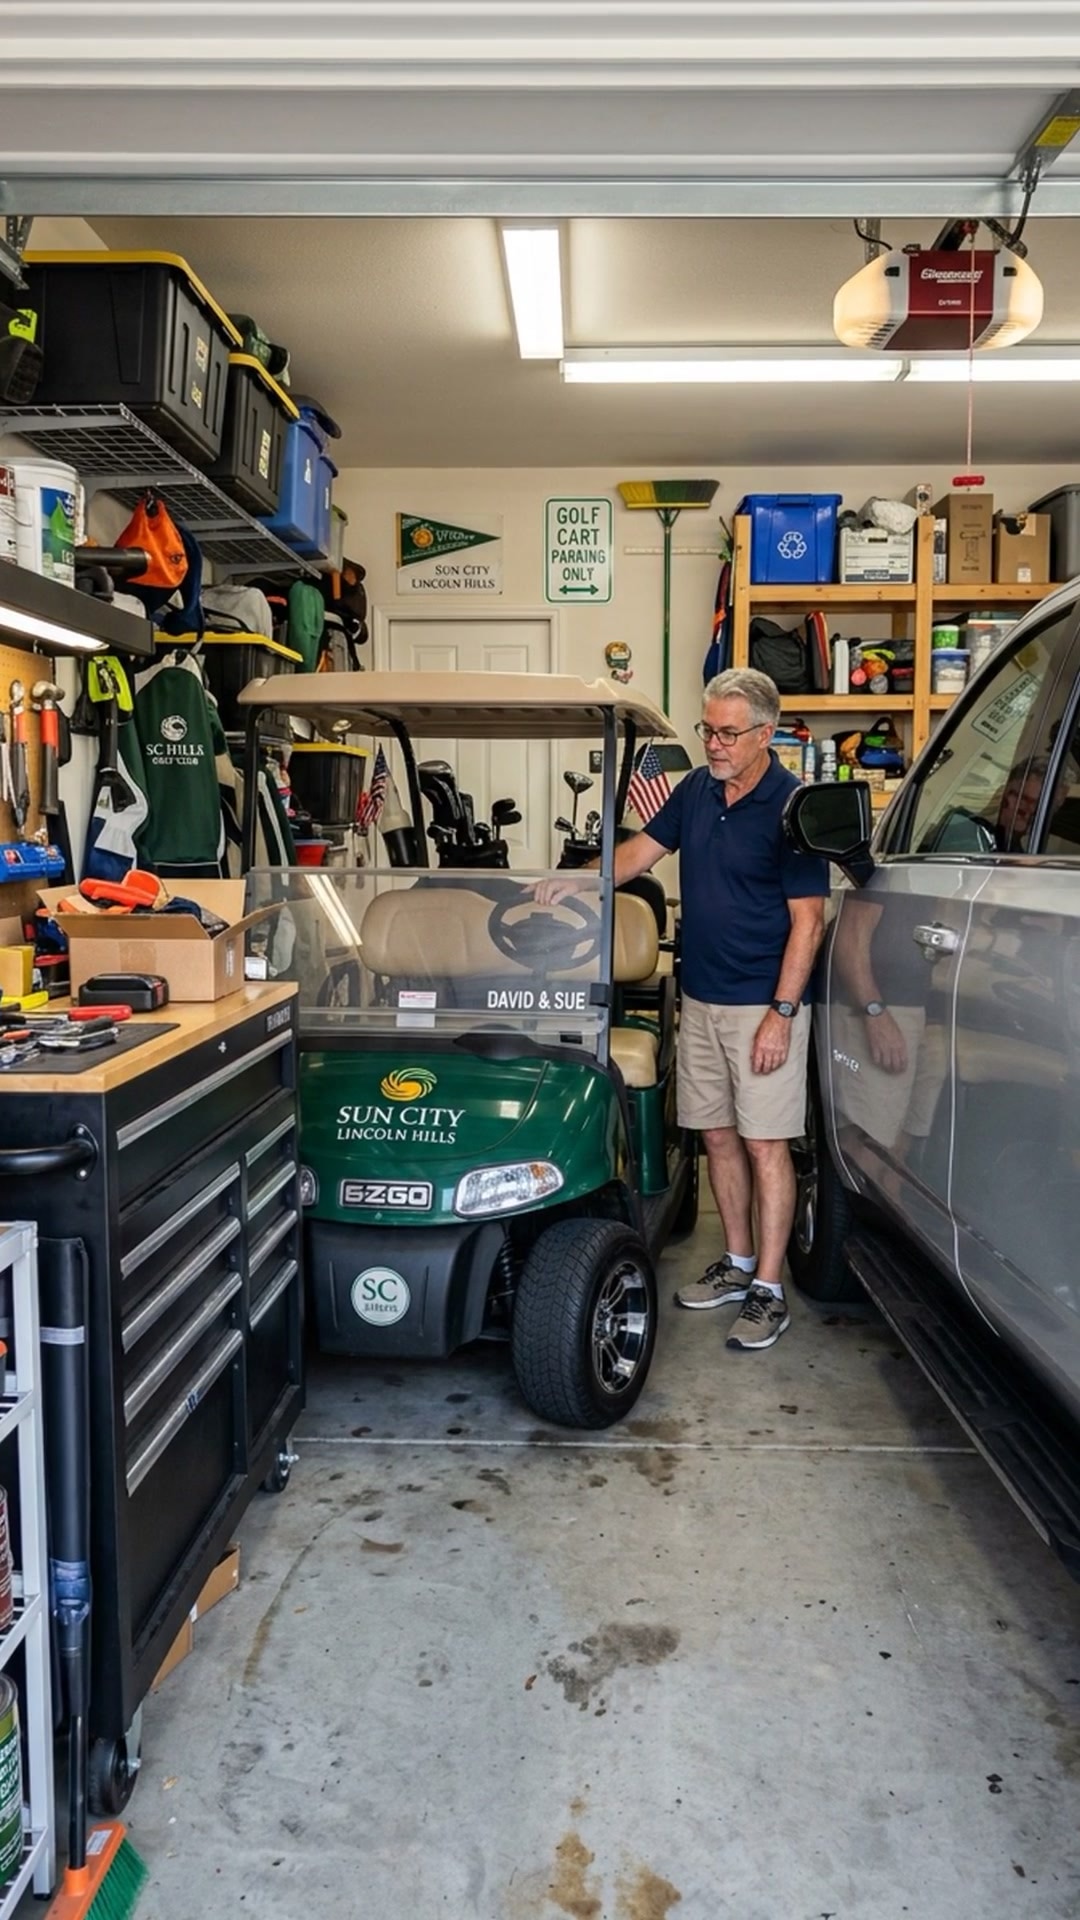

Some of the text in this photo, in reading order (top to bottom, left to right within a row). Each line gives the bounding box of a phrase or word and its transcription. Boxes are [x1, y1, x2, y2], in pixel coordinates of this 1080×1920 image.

[556, 507, 600, 525] GOLF
[557, 528, 600, 546] CART
[463, 564, 490, 576] CITY
[562, 567, 595, 582] ONLY
[145, 743, 164, 756] SC
[487, 990, 586, 1010] DAVID & SUE
[336, 1105, 467, 1128] SUN CITY
[336, 1127, 457, 1145] LINCOLN HILLS
[362, 1278, 398, 1303] SC
